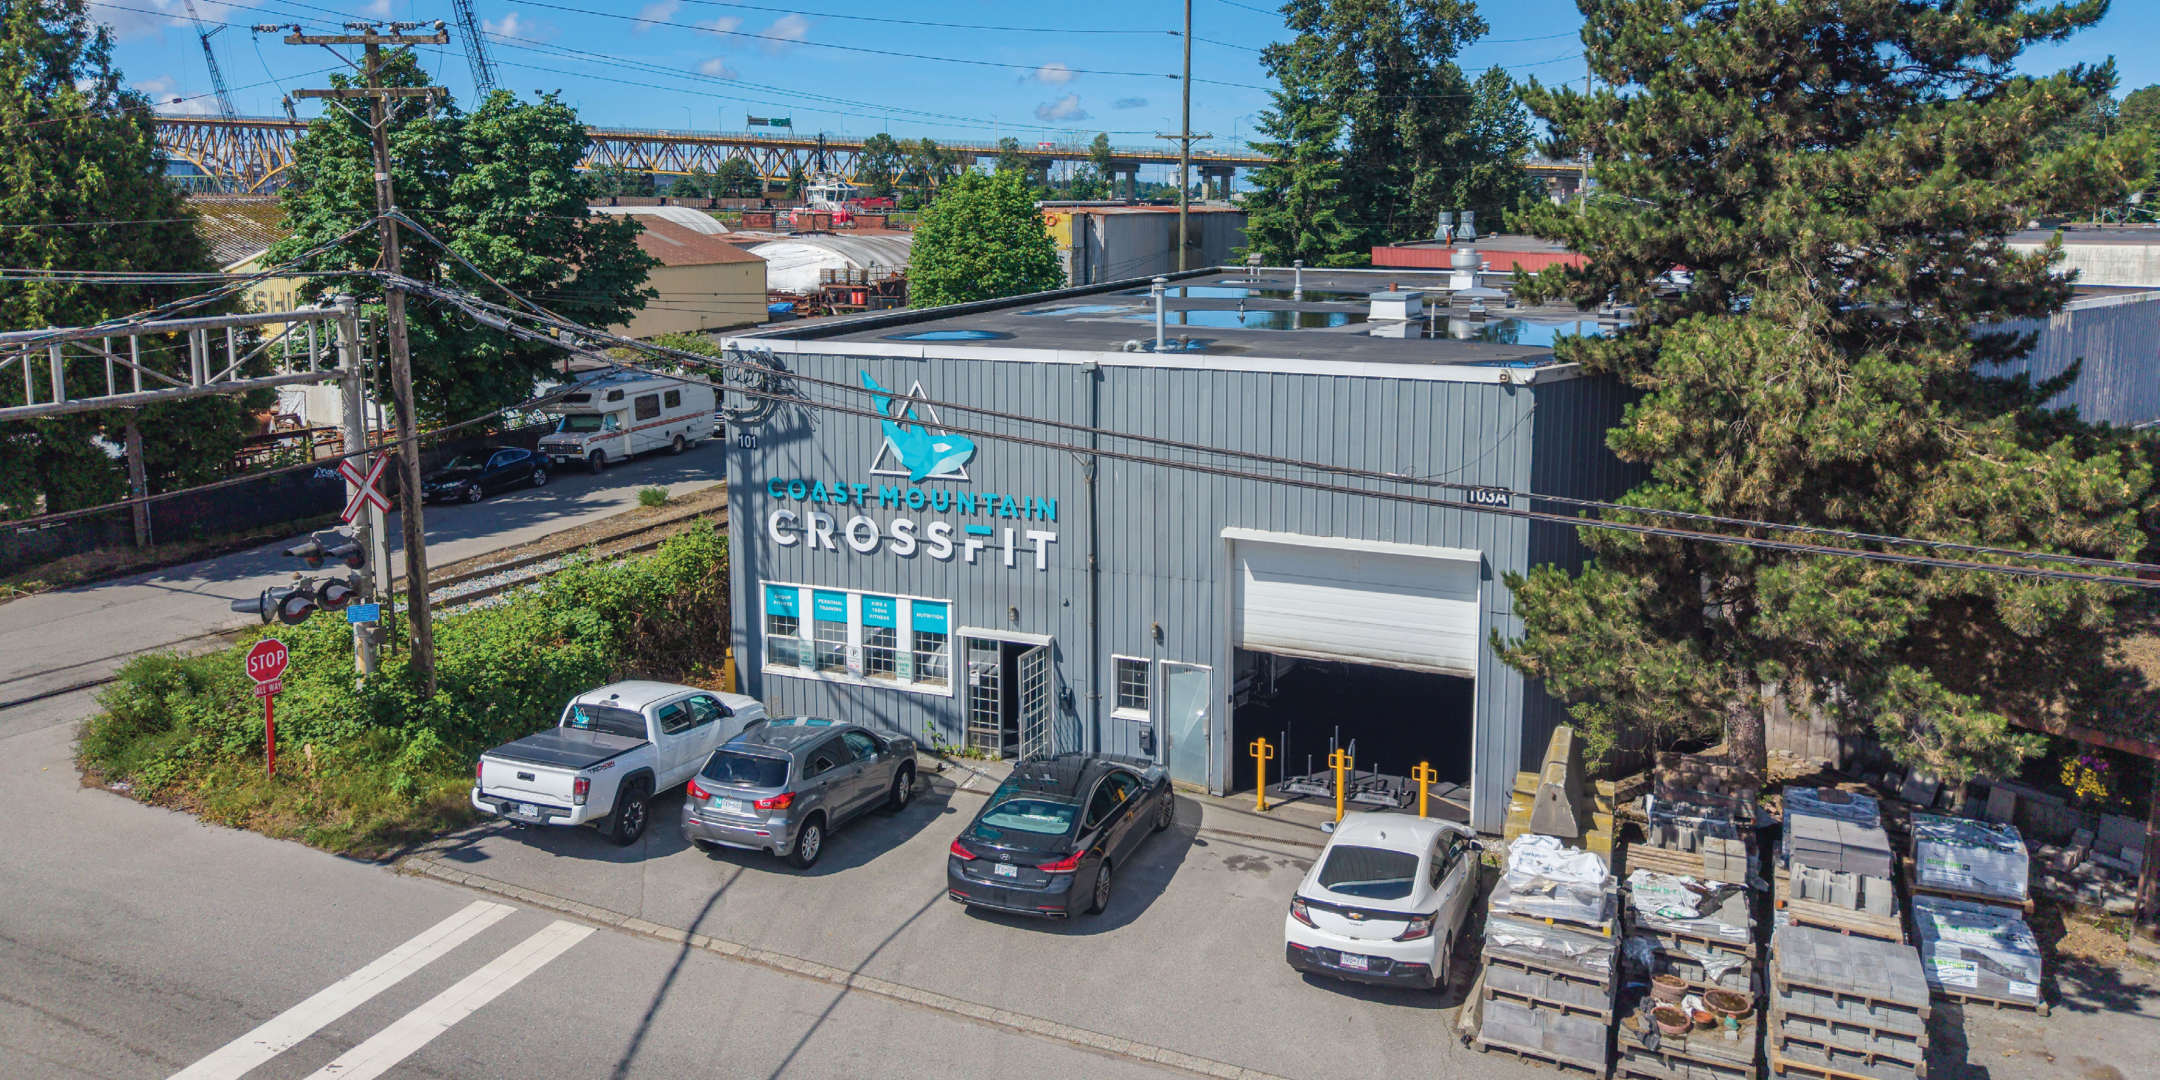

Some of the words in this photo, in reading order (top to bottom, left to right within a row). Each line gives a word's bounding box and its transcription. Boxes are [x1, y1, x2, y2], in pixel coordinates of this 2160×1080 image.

[738, 434, 756, 448] 101
[767, 477, 868, 505] COAST
[879, 484, 1056, 521] MOUNTAIN
[1470, 488, 1508, 504] 103A
[768, 509, 1057, 570] CROSSFIT
[250, 650, 285, 672] STOP
[255, 685, 267, 695] ALL
[269, 683, 282, 692] WAY
